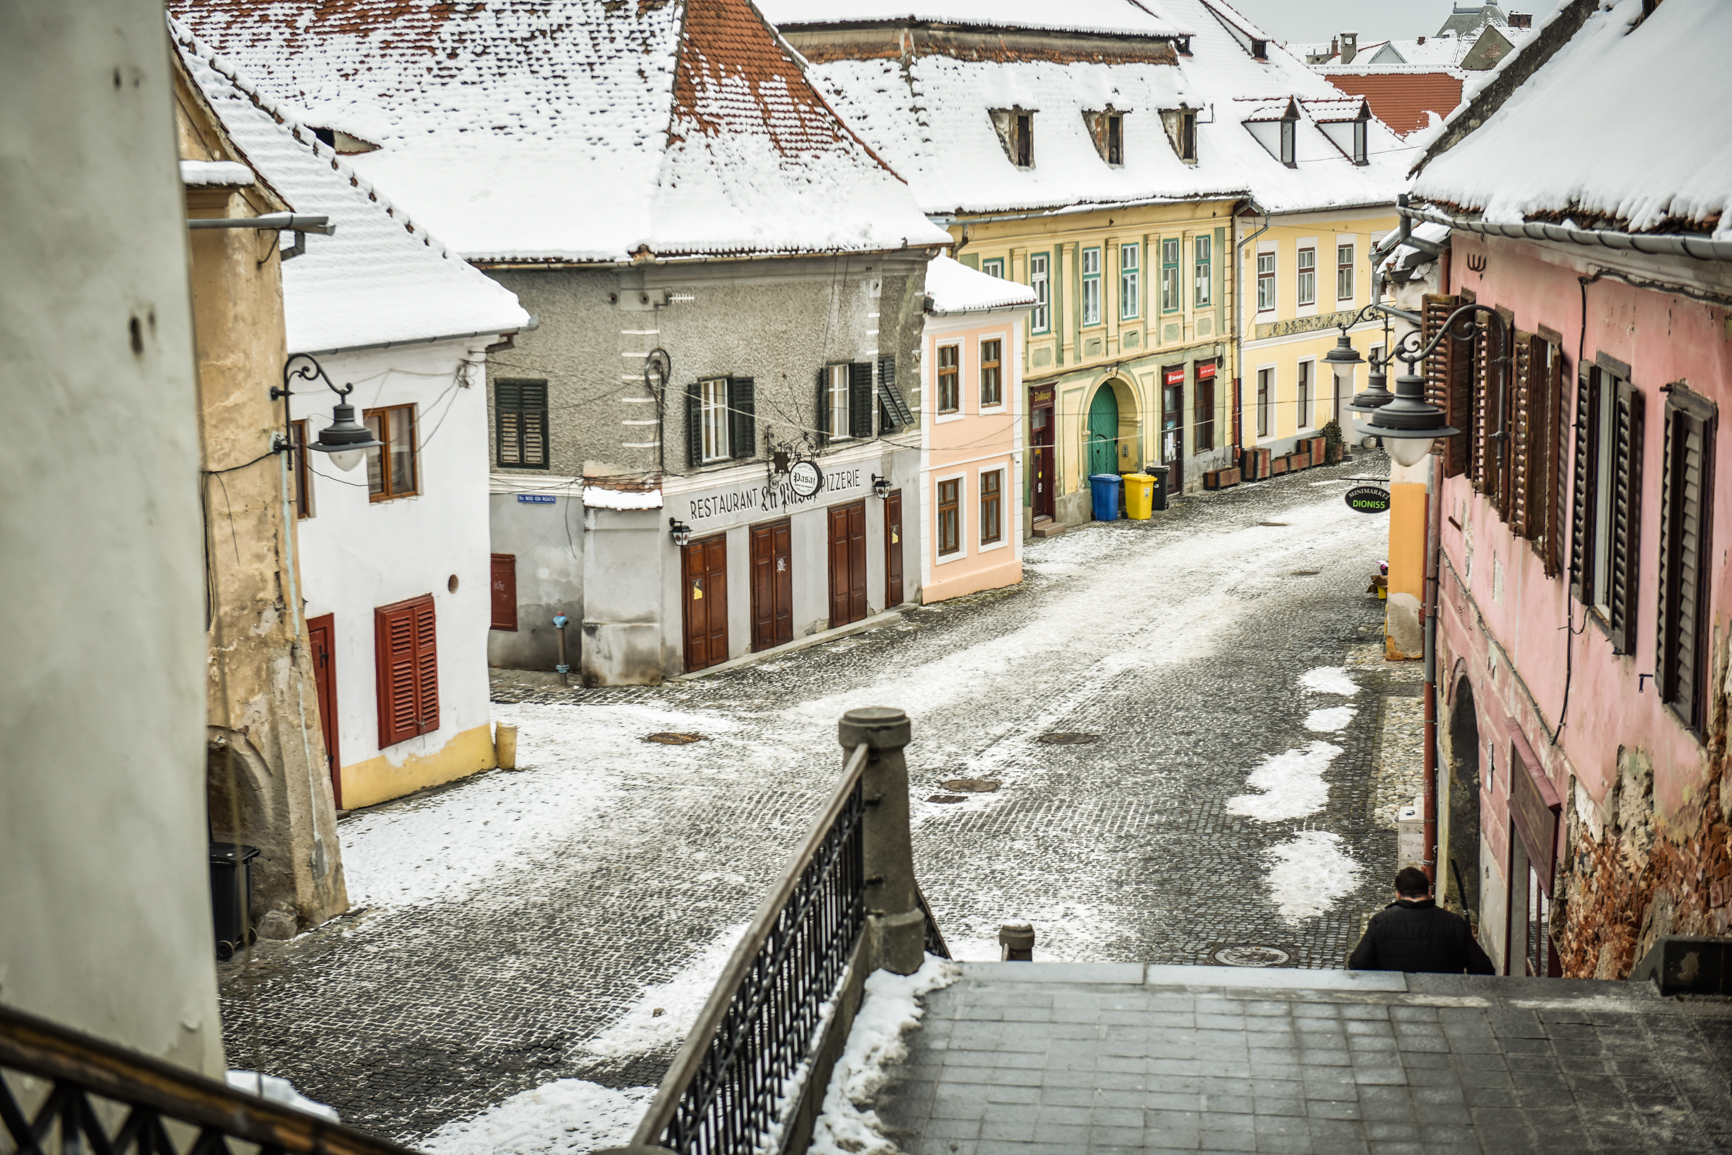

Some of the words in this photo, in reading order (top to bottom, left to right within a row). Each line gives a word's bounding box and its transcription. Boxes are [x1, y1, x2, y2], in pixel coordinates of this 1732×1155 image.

[1348, 488, 1390, 500] MINIMARKET
[690, 488, 758, 520] RESTAURANT
[1352, 499, 1386, 509] DIONISS
